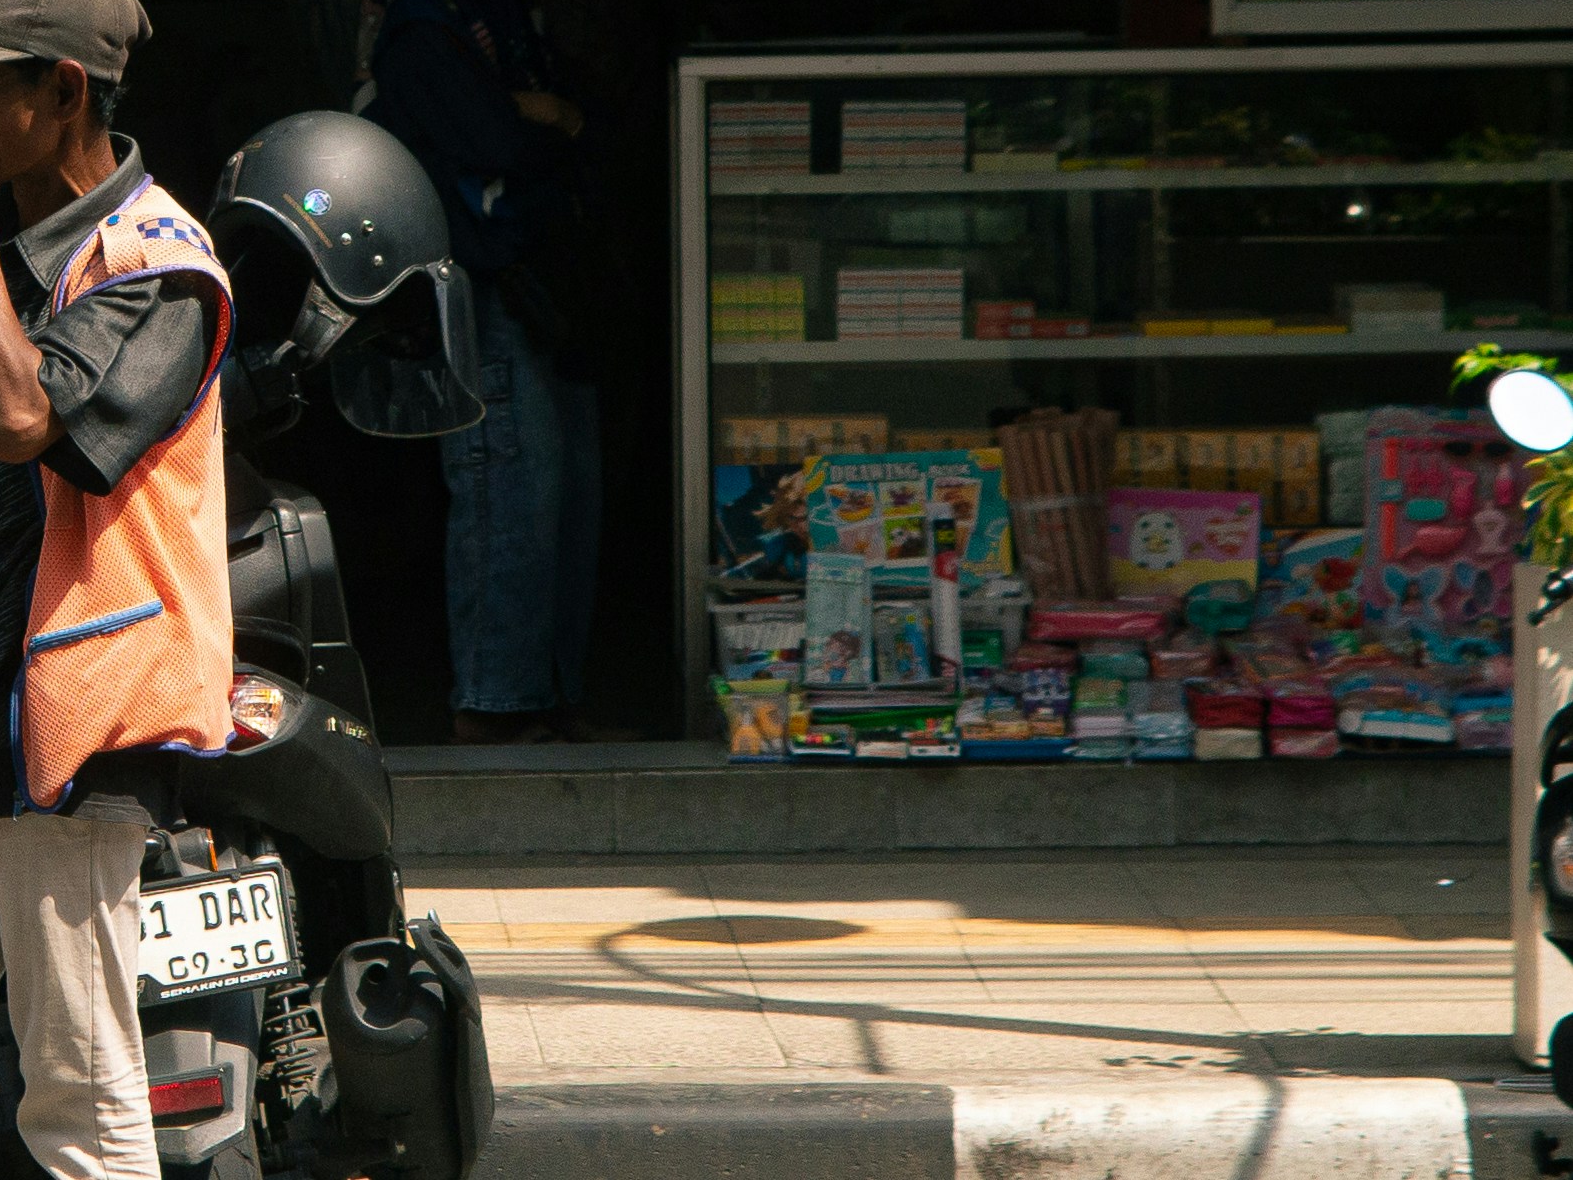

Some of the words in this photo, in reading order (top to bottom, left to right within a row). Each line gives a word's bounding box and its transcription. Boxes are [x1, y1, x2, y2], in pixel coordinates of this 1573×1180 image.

[199, 883, 273, 931] DAR
[160, 979, 224, 999] SEMAKIN
[224, 976, 241, 987] DI
[242, 967, 289, 984] DEPAN
